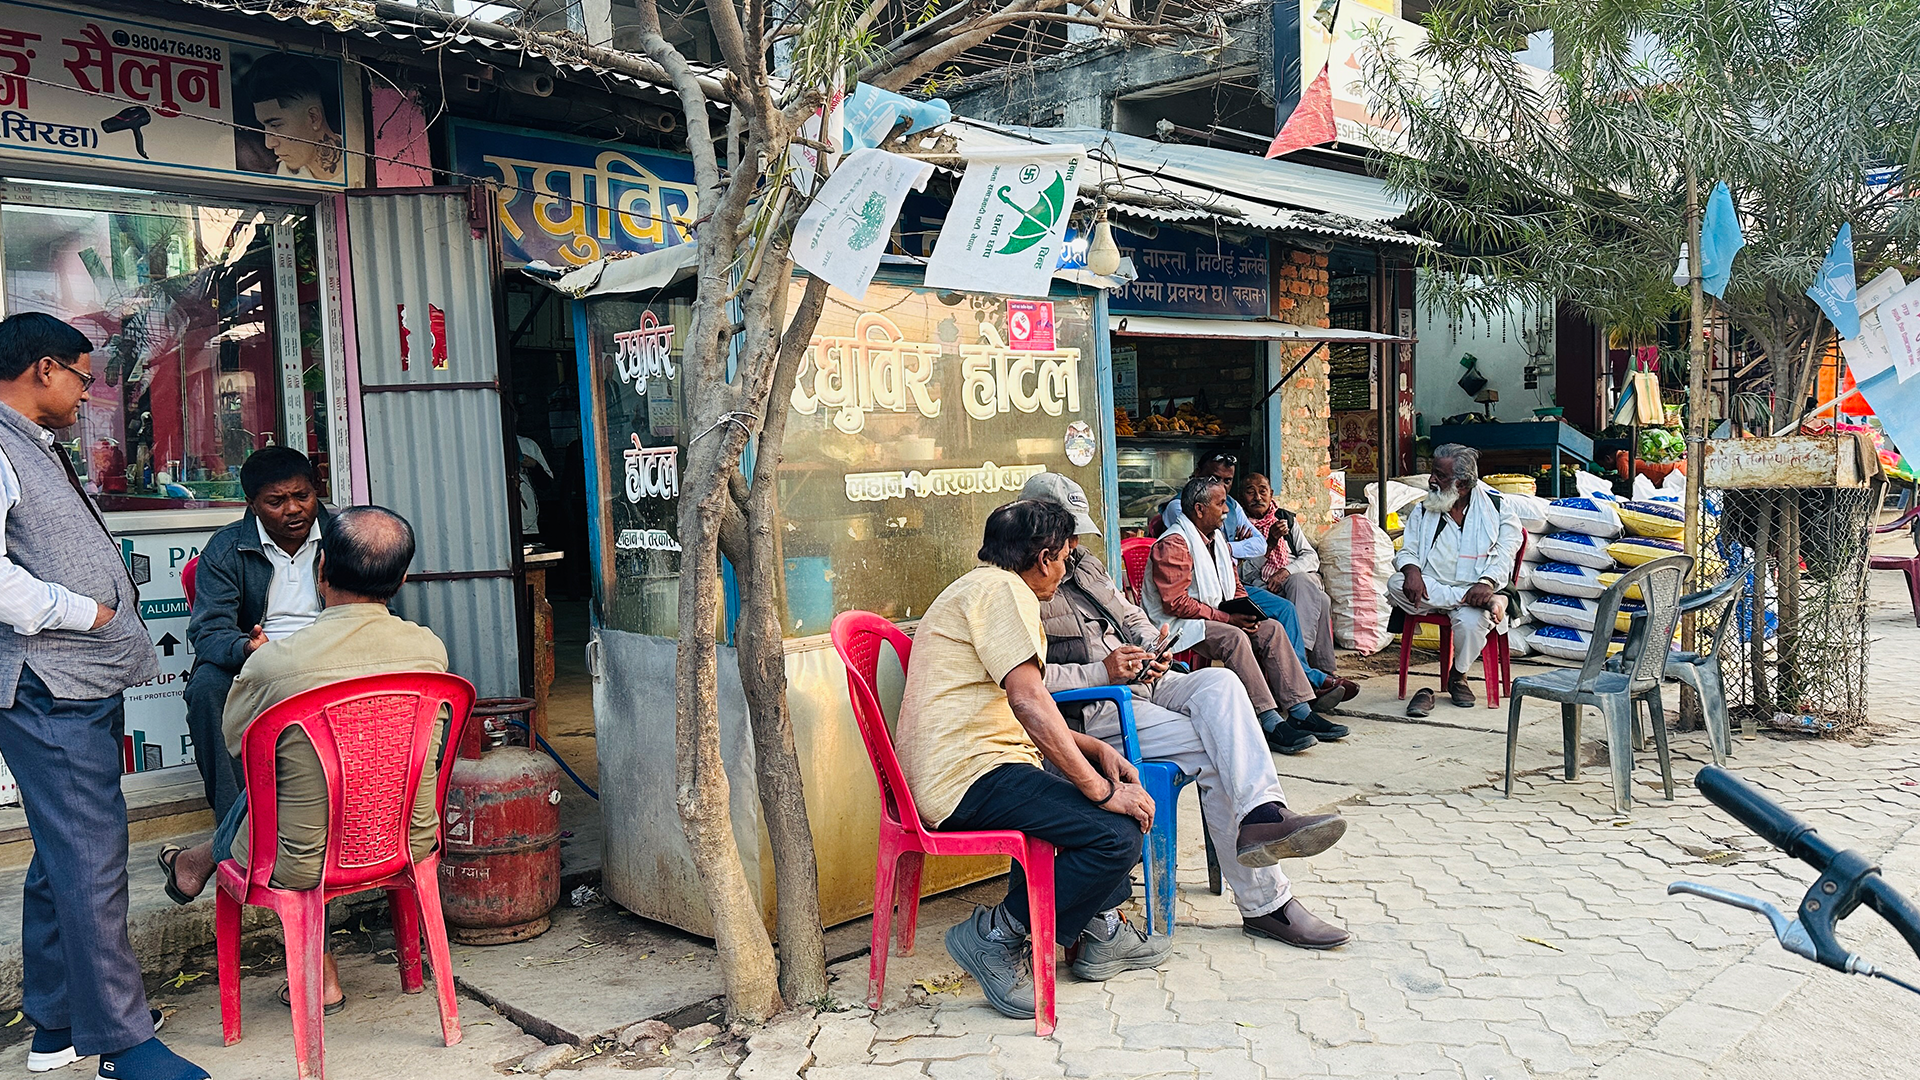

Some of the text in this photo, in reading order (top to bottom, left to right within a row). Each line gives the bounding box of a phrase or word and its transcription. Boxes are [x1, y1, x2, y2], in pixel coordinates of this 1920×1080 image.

[131, 33, 222, 62] 9804764838
[62, 23, 223, 118] सैलुन
[0, 111, 98, 149] सिरहा)
[1065, 157, 1080, 182] चुनाव
[982, 213, 1004, 259] छाता छाप
[1034, 246, 1050, 270] चिन्ह
[1143, 248, 1190, 276] नास्ता,
[613, 309, 676, 396] रघुविर
[789, 311, 943, 435] रघुविर
[958, 322, 1082, 422] होटल
[623, 432, 680, 504] होटल
[932, 463, 997, 494] तरकारी
[157, 673, 177, 685] UP
[144, 690, 185, 700] PROTECTIO
[461, 866, 491, 880] ग्यास
[103, 1061, 115, 1072] G
